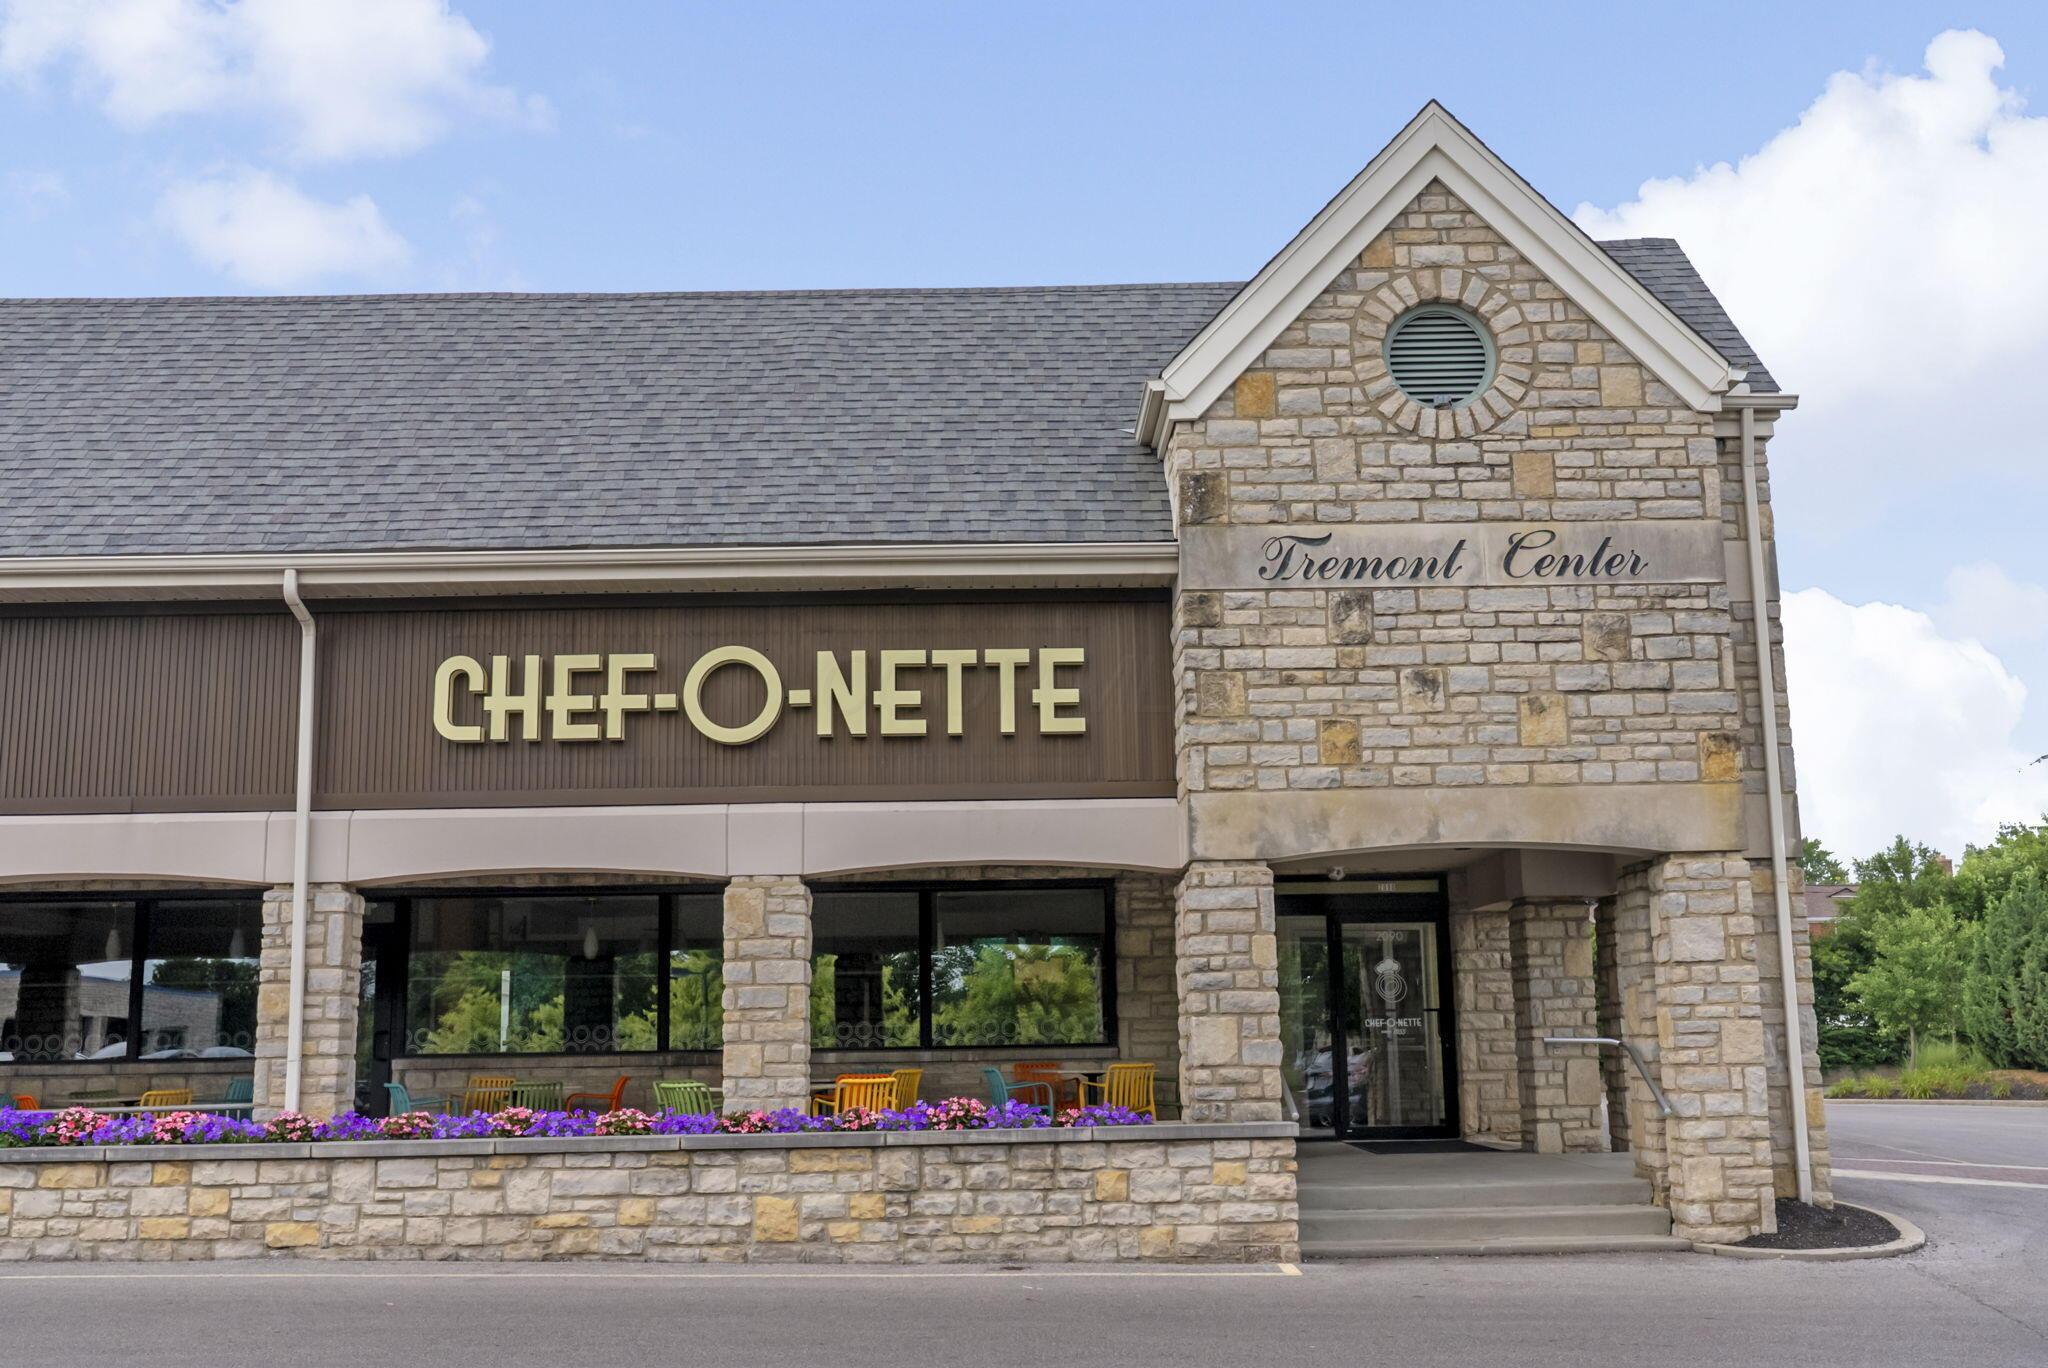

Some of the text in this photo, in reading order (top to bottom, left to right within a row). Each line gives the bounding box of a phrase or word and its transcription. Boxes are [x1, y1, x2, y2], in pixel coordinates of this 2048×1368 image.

[1258, 529, 1649, 581] Tremont Center
[433, 645, 1087, 745] CHEF-O-NETTE
[1364, 1017, 1422, 1028] CHEF-O-NETTE
